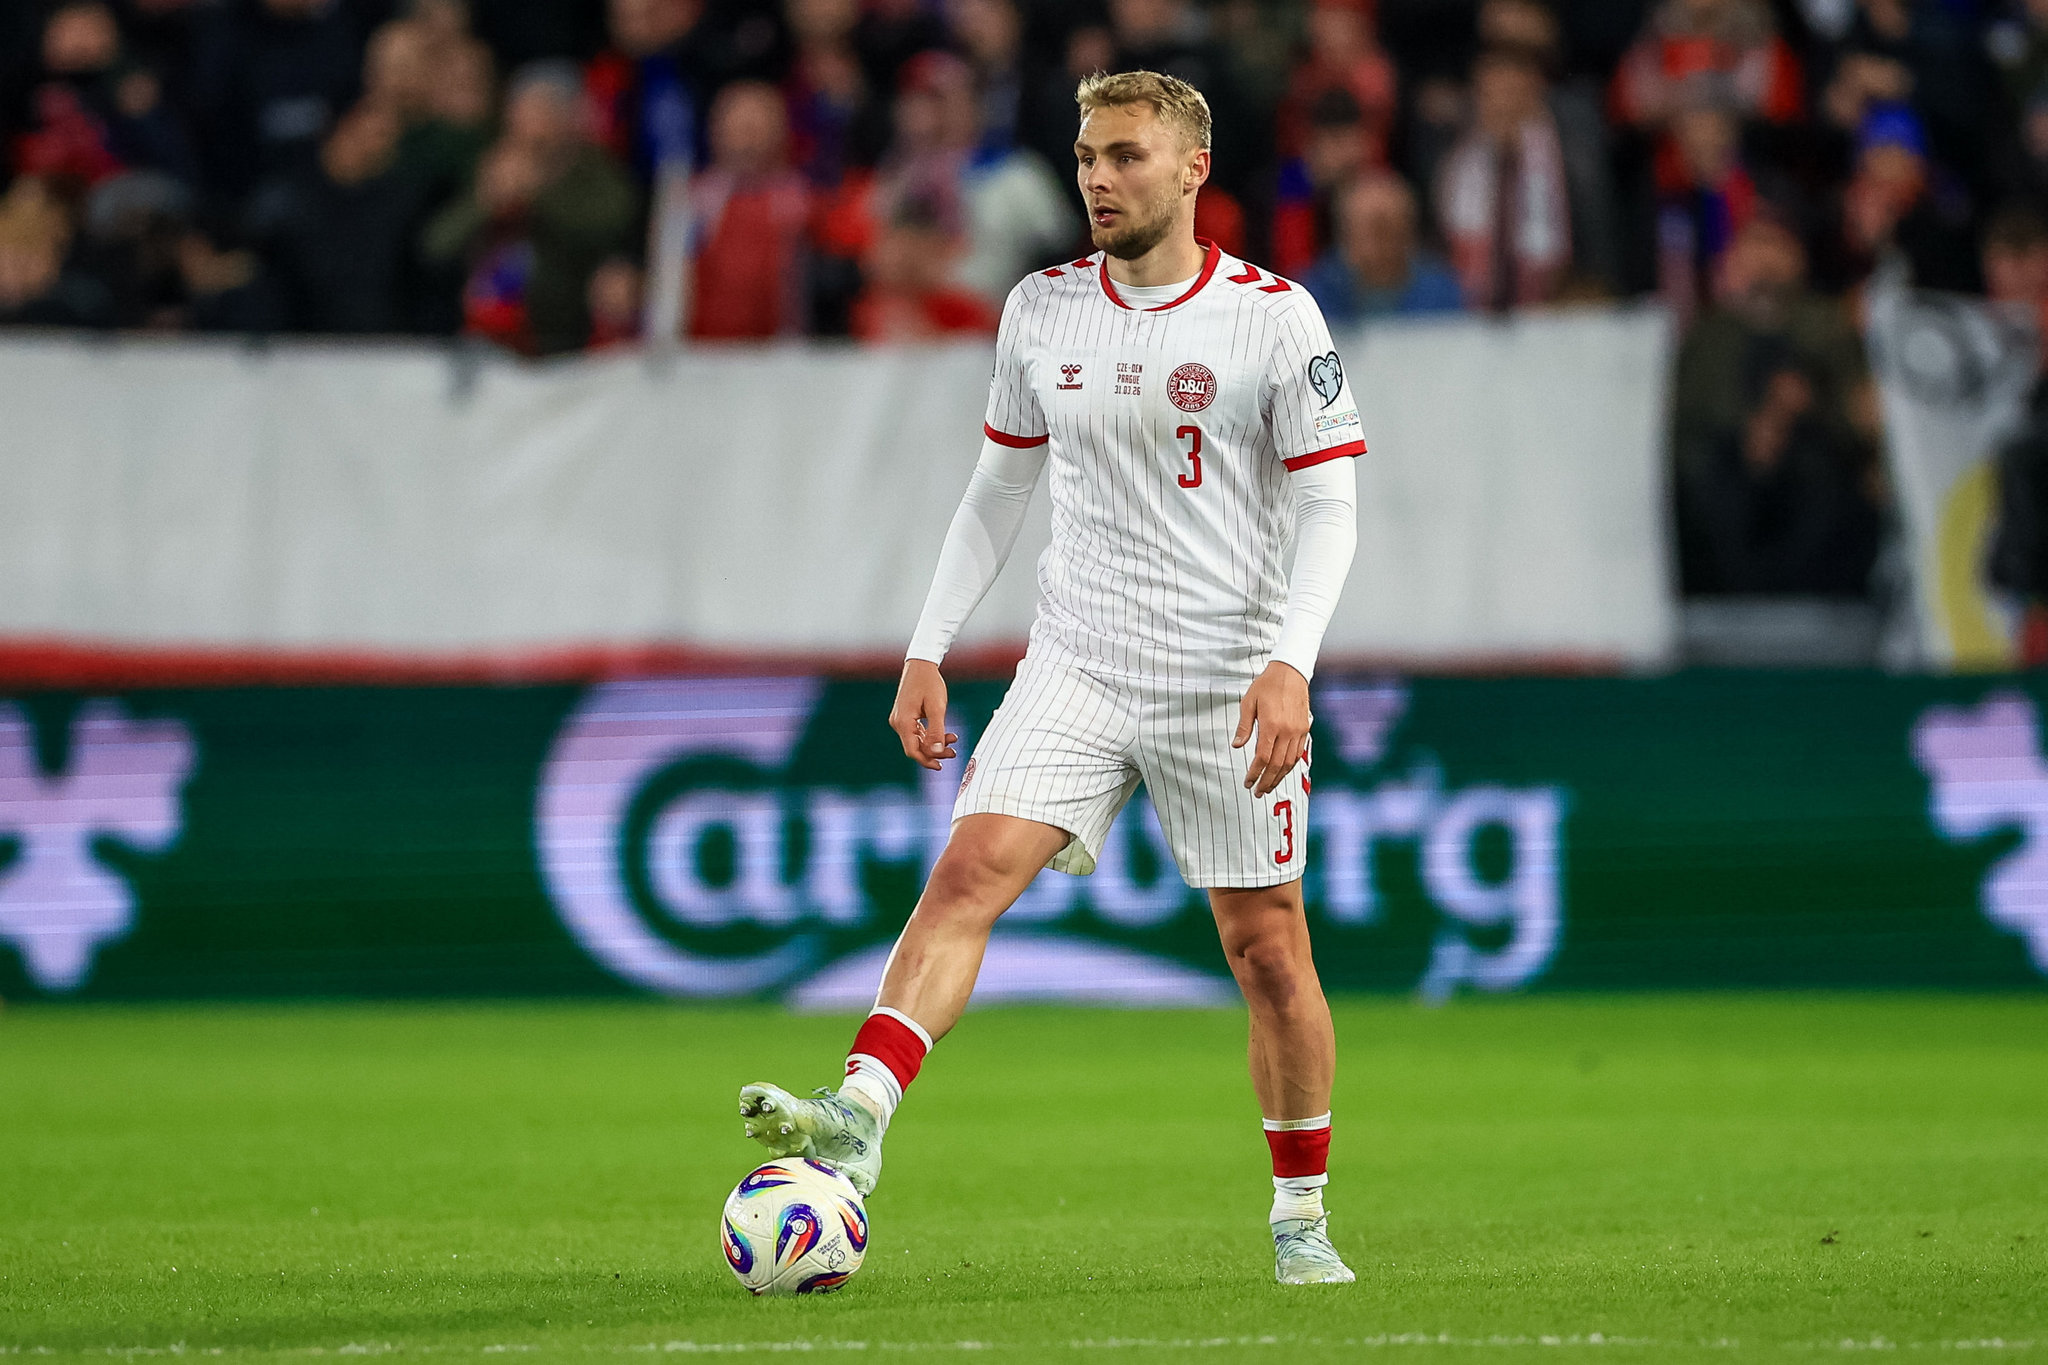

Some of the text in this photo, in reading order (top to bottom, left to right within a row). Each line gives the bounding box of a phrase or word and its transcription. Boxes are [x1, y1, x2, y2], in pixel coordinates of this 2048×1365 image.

[1117, 373, 1140, 385] PRAGUE
[1177, 379, 1206, 394] DBU
[1114, 384, 1141, 396] 31.03.26
[1176, 425, 1202, 488] 3
[1274, 799, 1293, 864] 3
